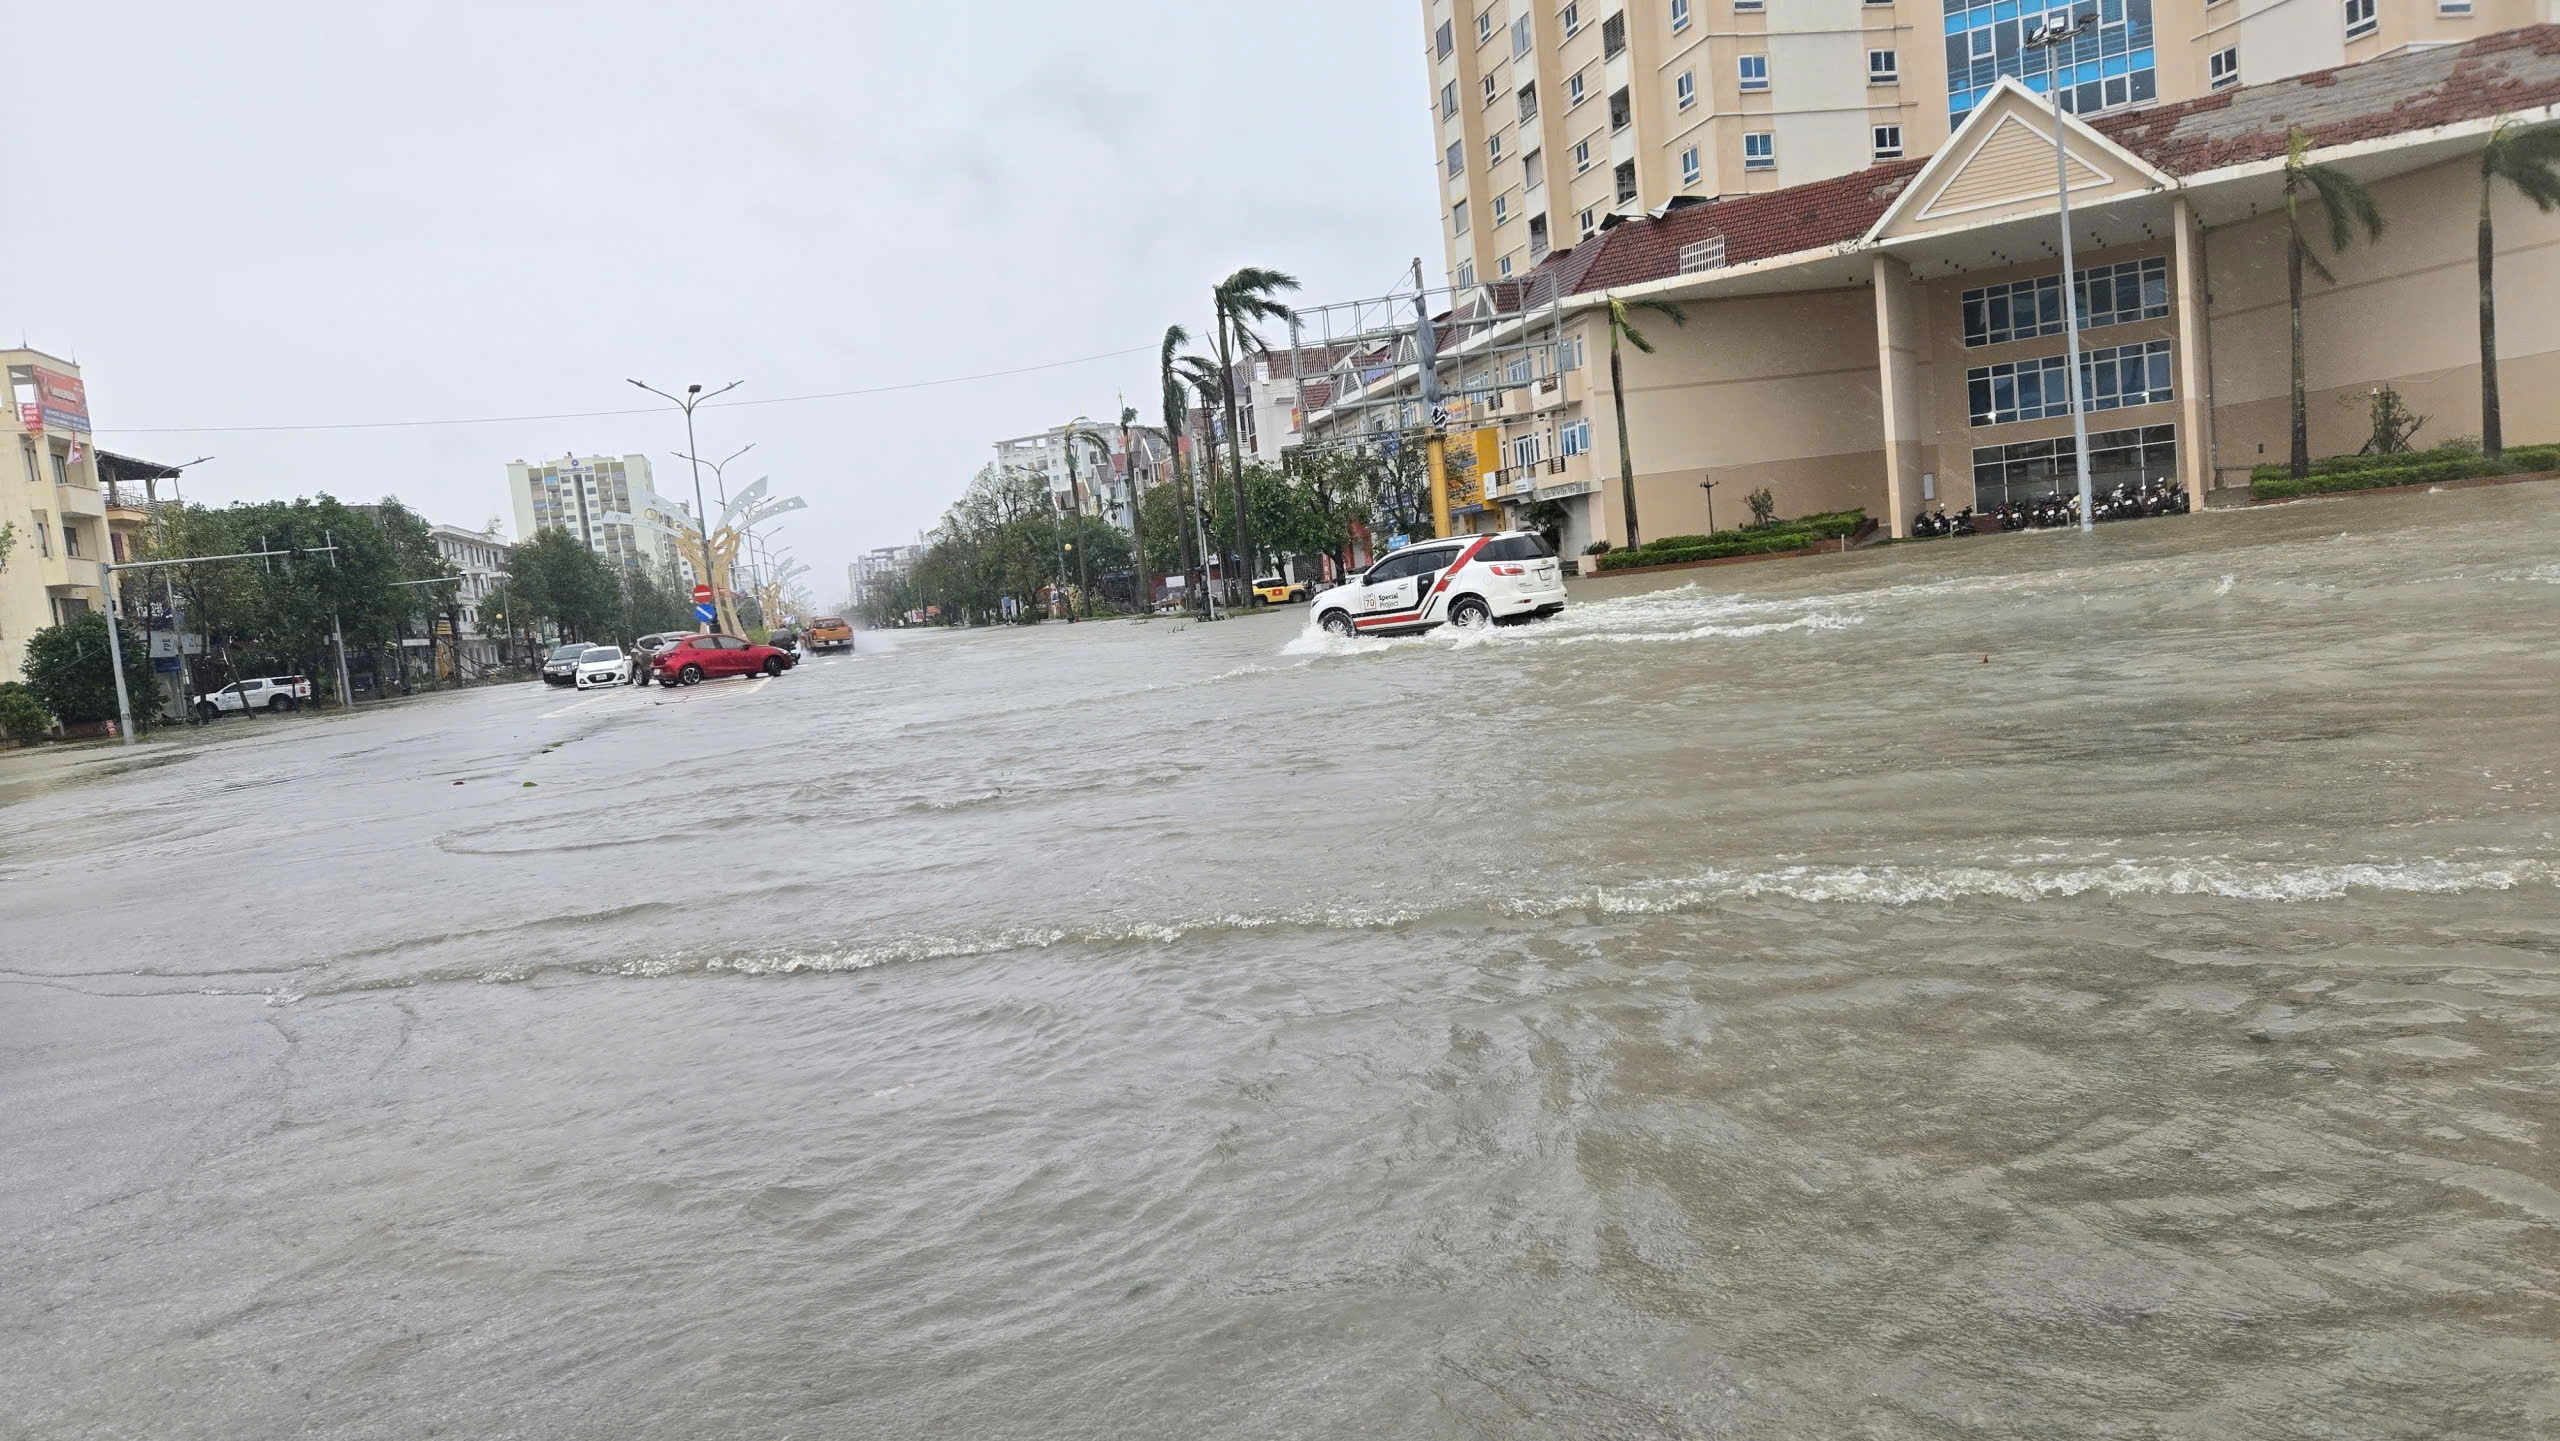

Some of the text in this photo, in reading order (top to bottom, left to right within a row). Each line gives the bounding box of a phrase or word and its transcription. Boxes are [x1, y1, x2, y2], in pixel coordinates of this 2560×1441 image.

[1378, 593, 1398, 602] Special
[1366, 598, 1374, 607] 70
[1379, 601, 1399, 609] Project
